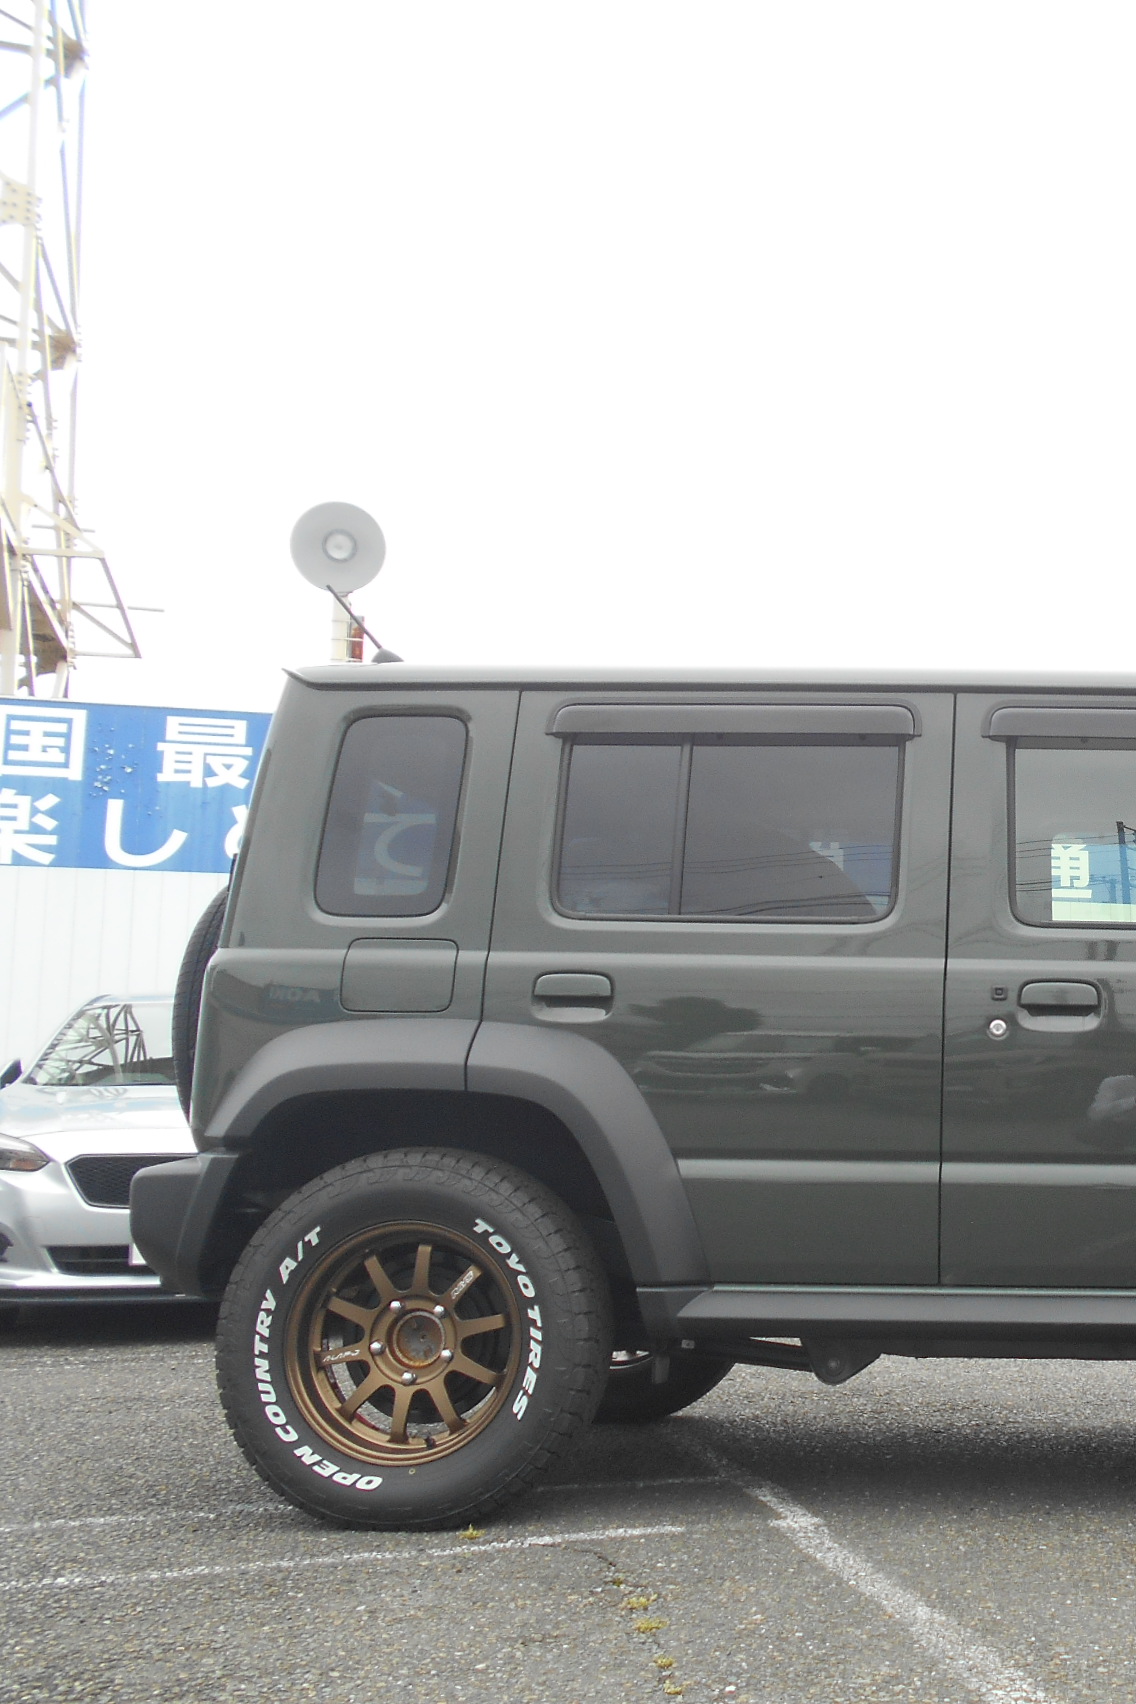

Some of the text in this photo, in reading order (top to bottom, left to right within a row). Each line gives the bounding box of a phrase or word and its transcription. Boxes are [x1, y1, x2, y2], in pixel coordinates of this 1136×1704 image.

[253, 1225, 383, 1491] OPEN COUNTRY A/T
[472, 1218, 543, 1421] TOYO TIRES
